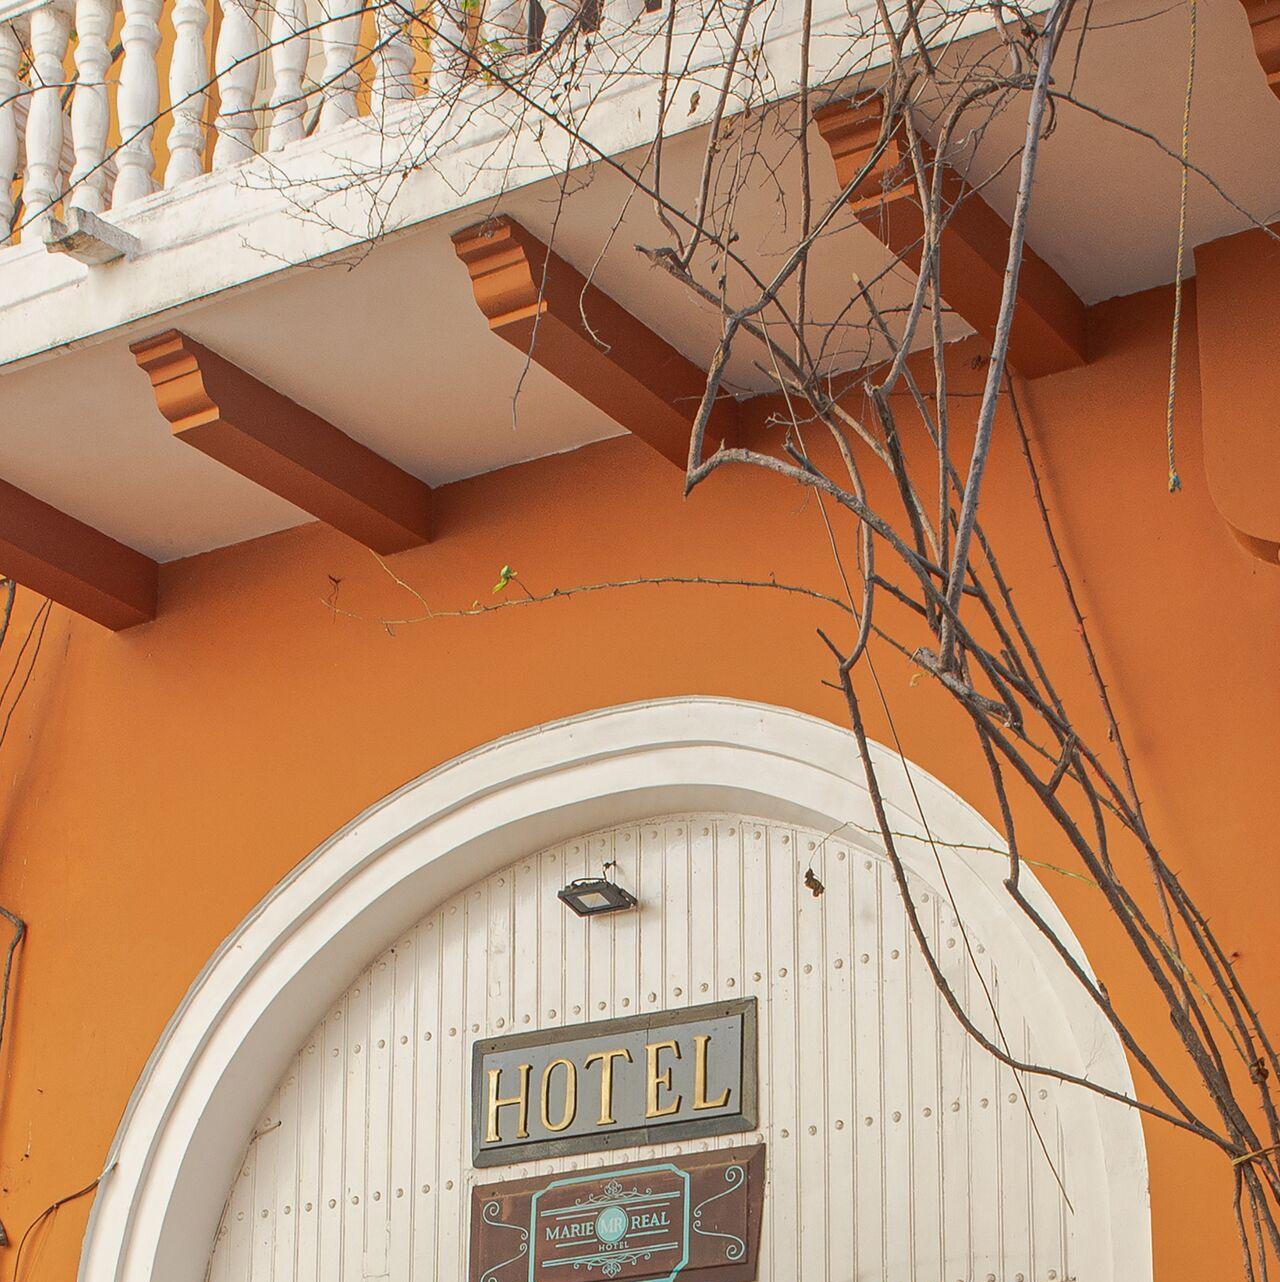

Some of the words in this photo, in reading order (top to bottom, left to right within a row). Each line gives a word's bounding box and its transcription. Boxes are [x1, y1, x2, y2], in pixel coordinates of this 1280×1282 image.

[484, 1034, 732, 1142] HOTEL
[545, 1221, 595, 1241] MARIE
[631, 1211, 671, 1230] REAL
[598, 1241, 630, 1252] HOTEL
